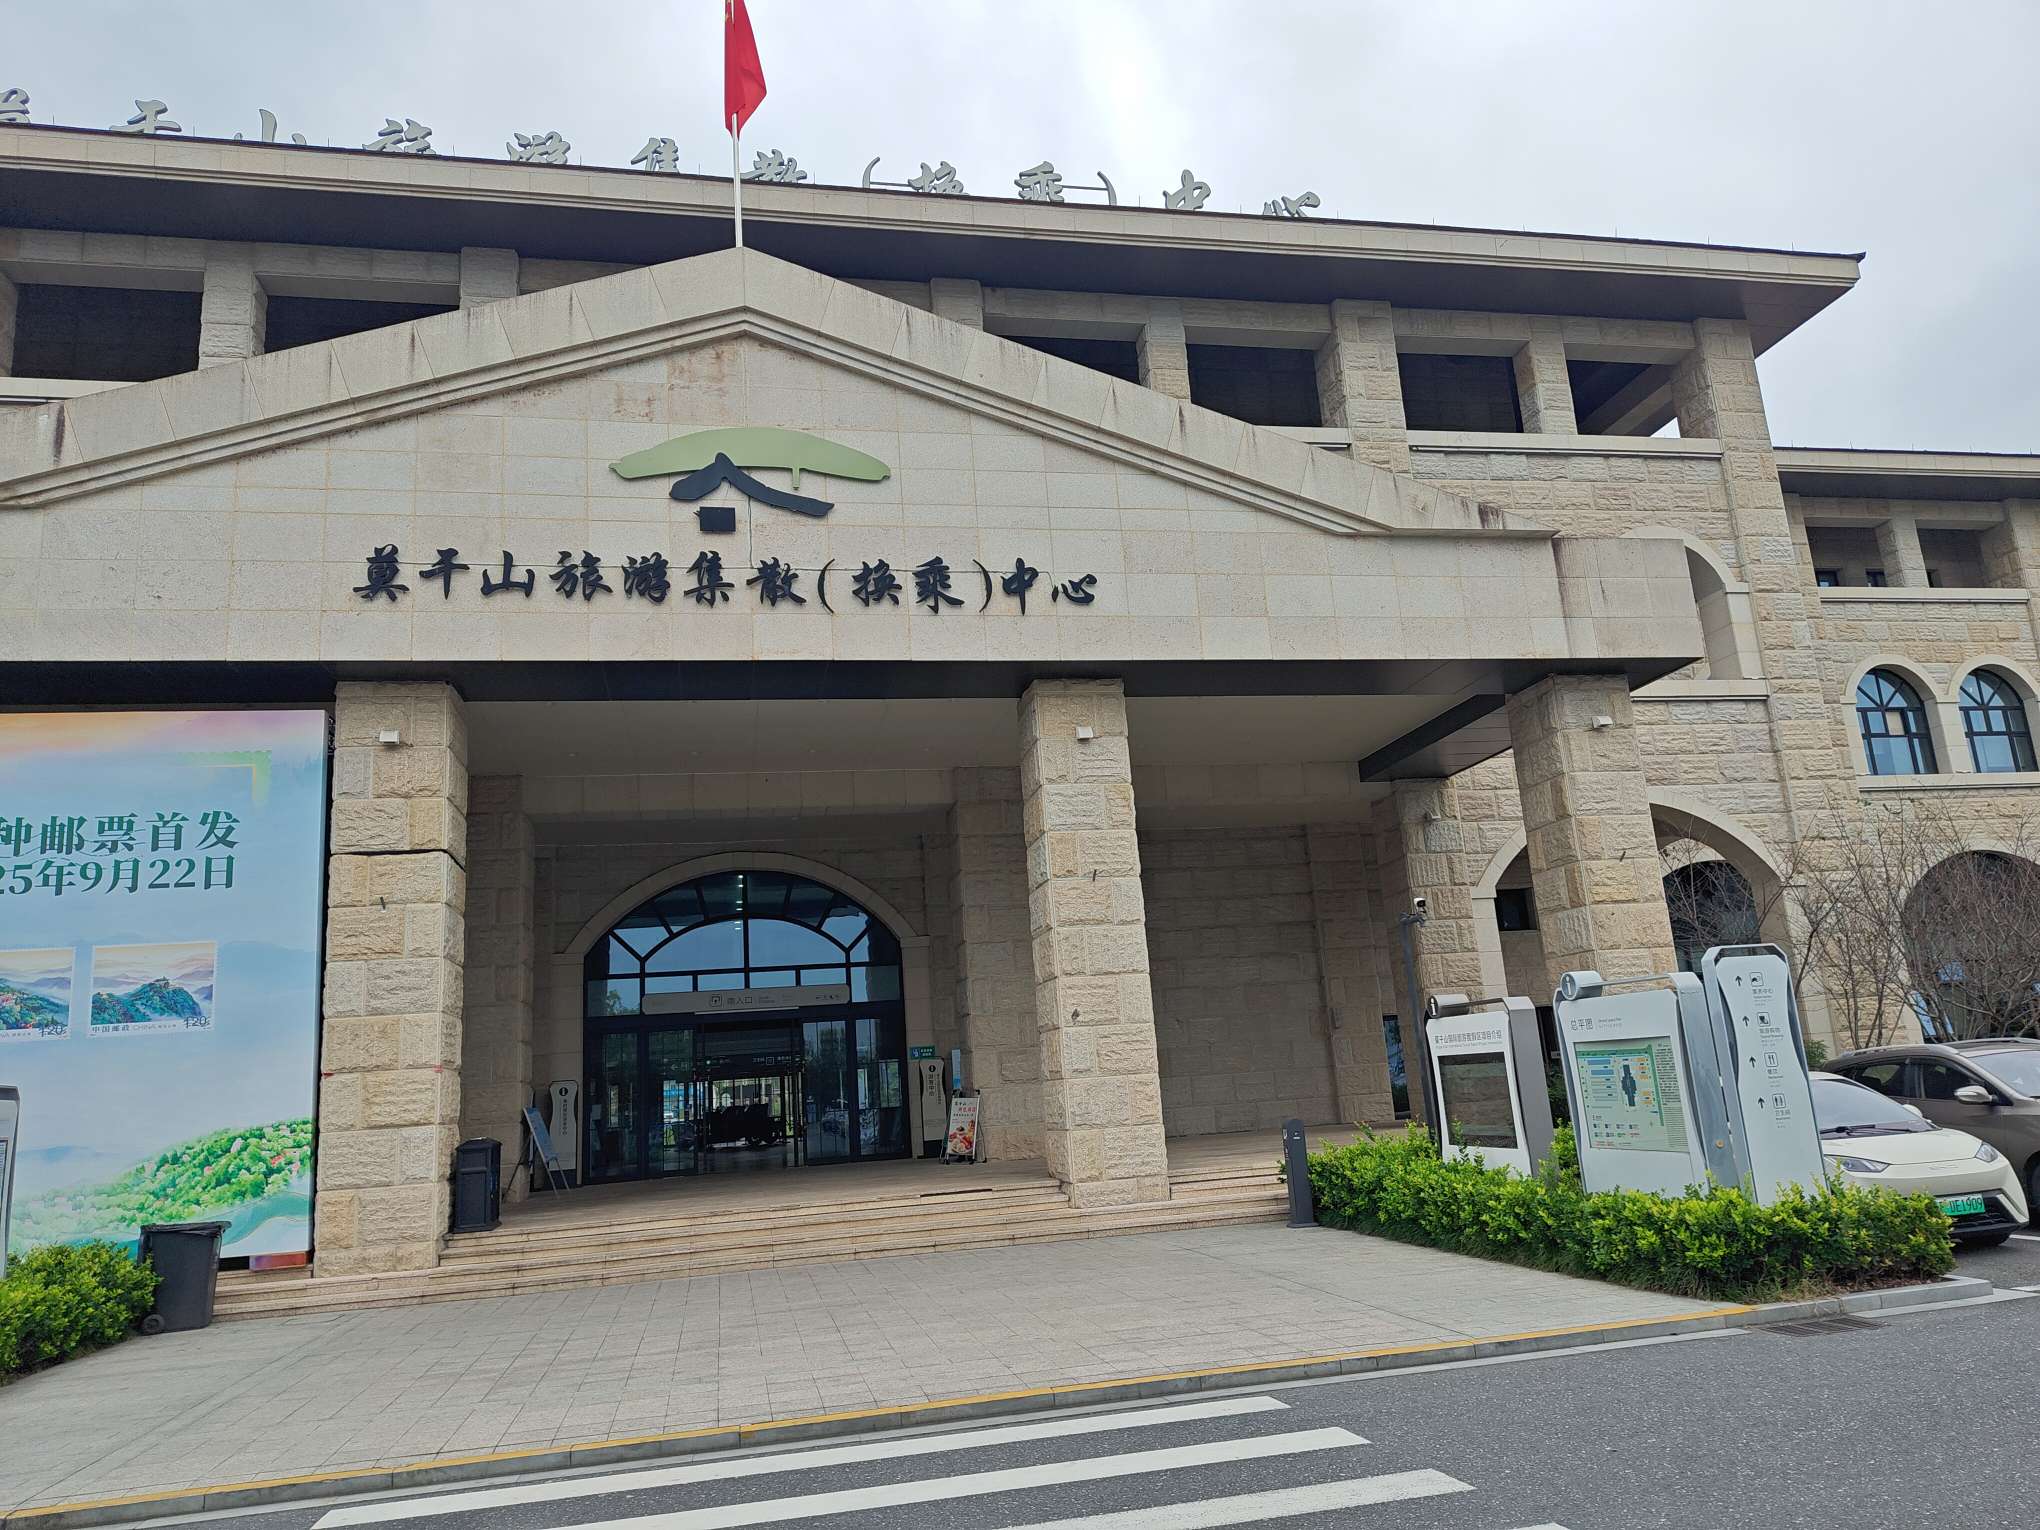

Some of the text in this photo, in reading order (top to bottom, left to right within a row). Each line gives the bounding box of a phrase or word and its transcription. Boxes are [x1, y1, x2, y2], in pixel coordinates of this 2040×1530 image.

[353, 543, 1098, 615] 莫干山旅游集散（换乘）中心
